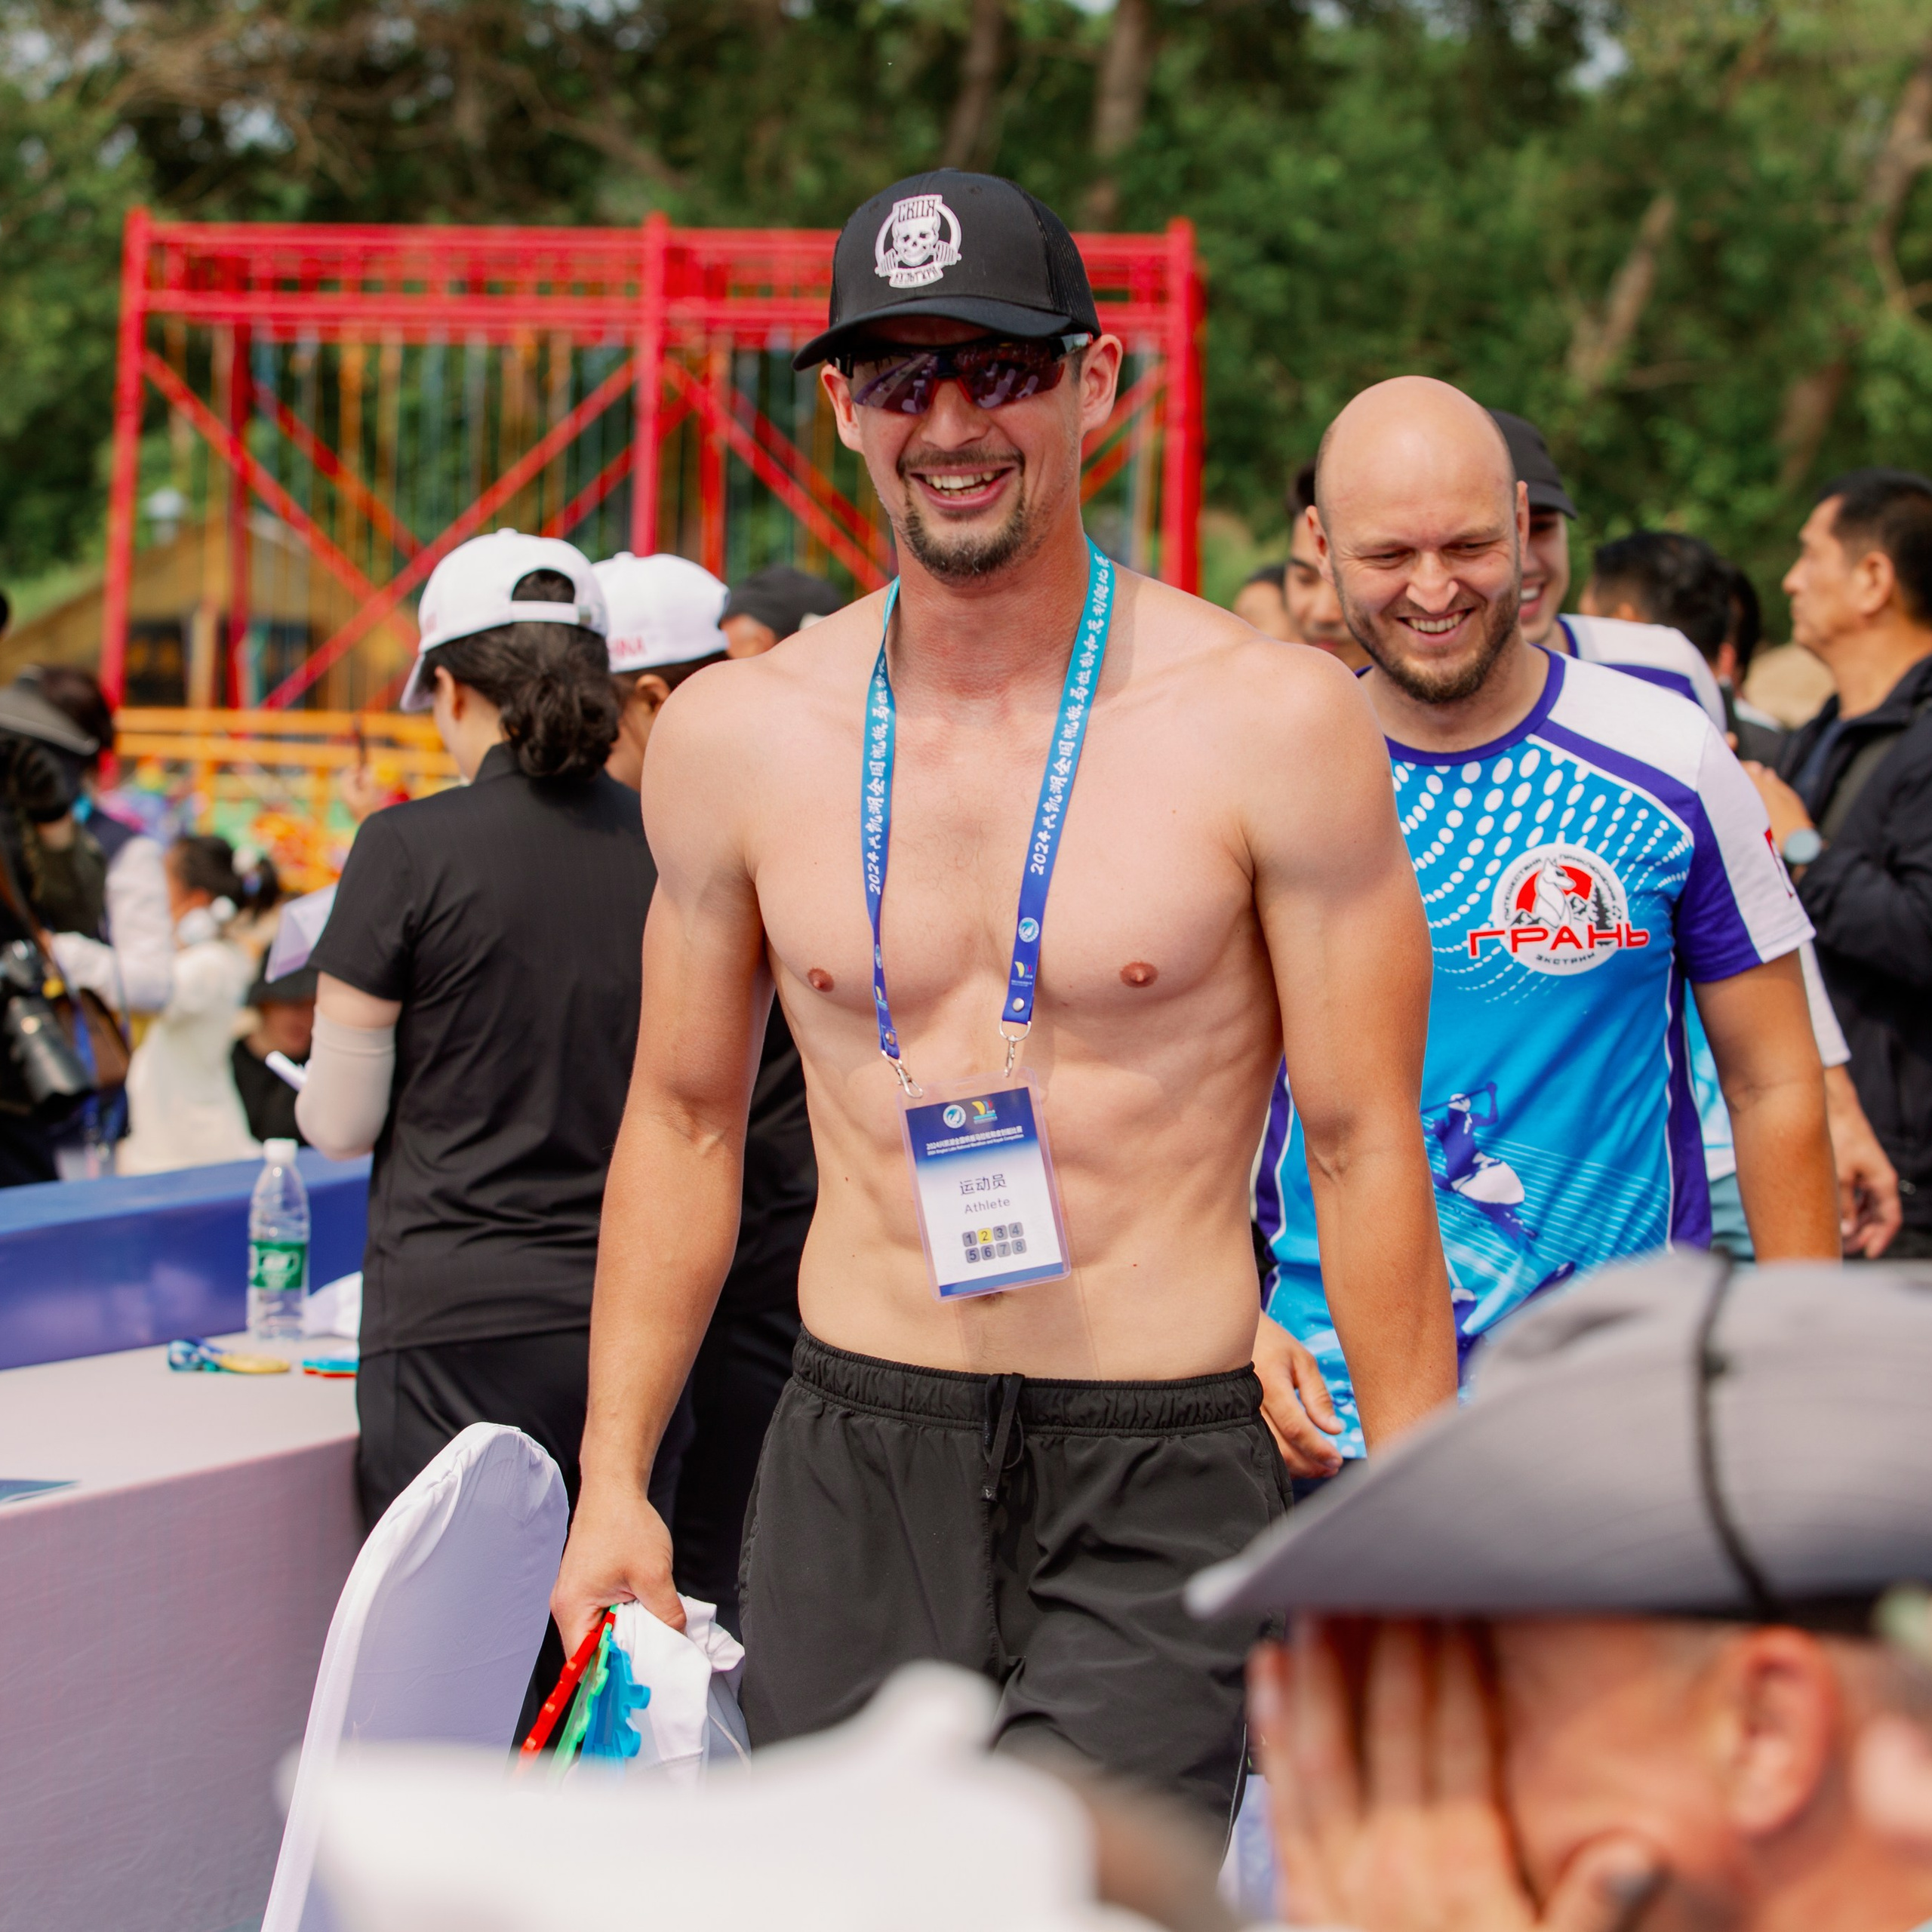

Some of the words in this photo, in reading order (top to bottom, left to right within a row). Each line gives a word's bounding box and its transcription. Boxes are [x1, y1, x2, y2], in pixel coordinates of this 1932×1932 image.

[1469, 921, 1651, 957] ГРАНЬ
[1535, 952, 1595, 965] ЭКСТРИМ
[959, 1174, 1007, 1195] 运动员
[964, 1198, 1011, 1214] Athlete
[966, 1234, 973, 1244] 1
[980, 1230, 989, 1241] 2
[996, 1227, 1004, 1238] 3
[1012, 1224, 1020, 1235] 4
[969, 1250, 977, 1261] 5
[984, 1247, 992, 1258] 6
[1000, 1244, 1007, 1255] 7
[1016, 1241, 1023, 1252] 8
